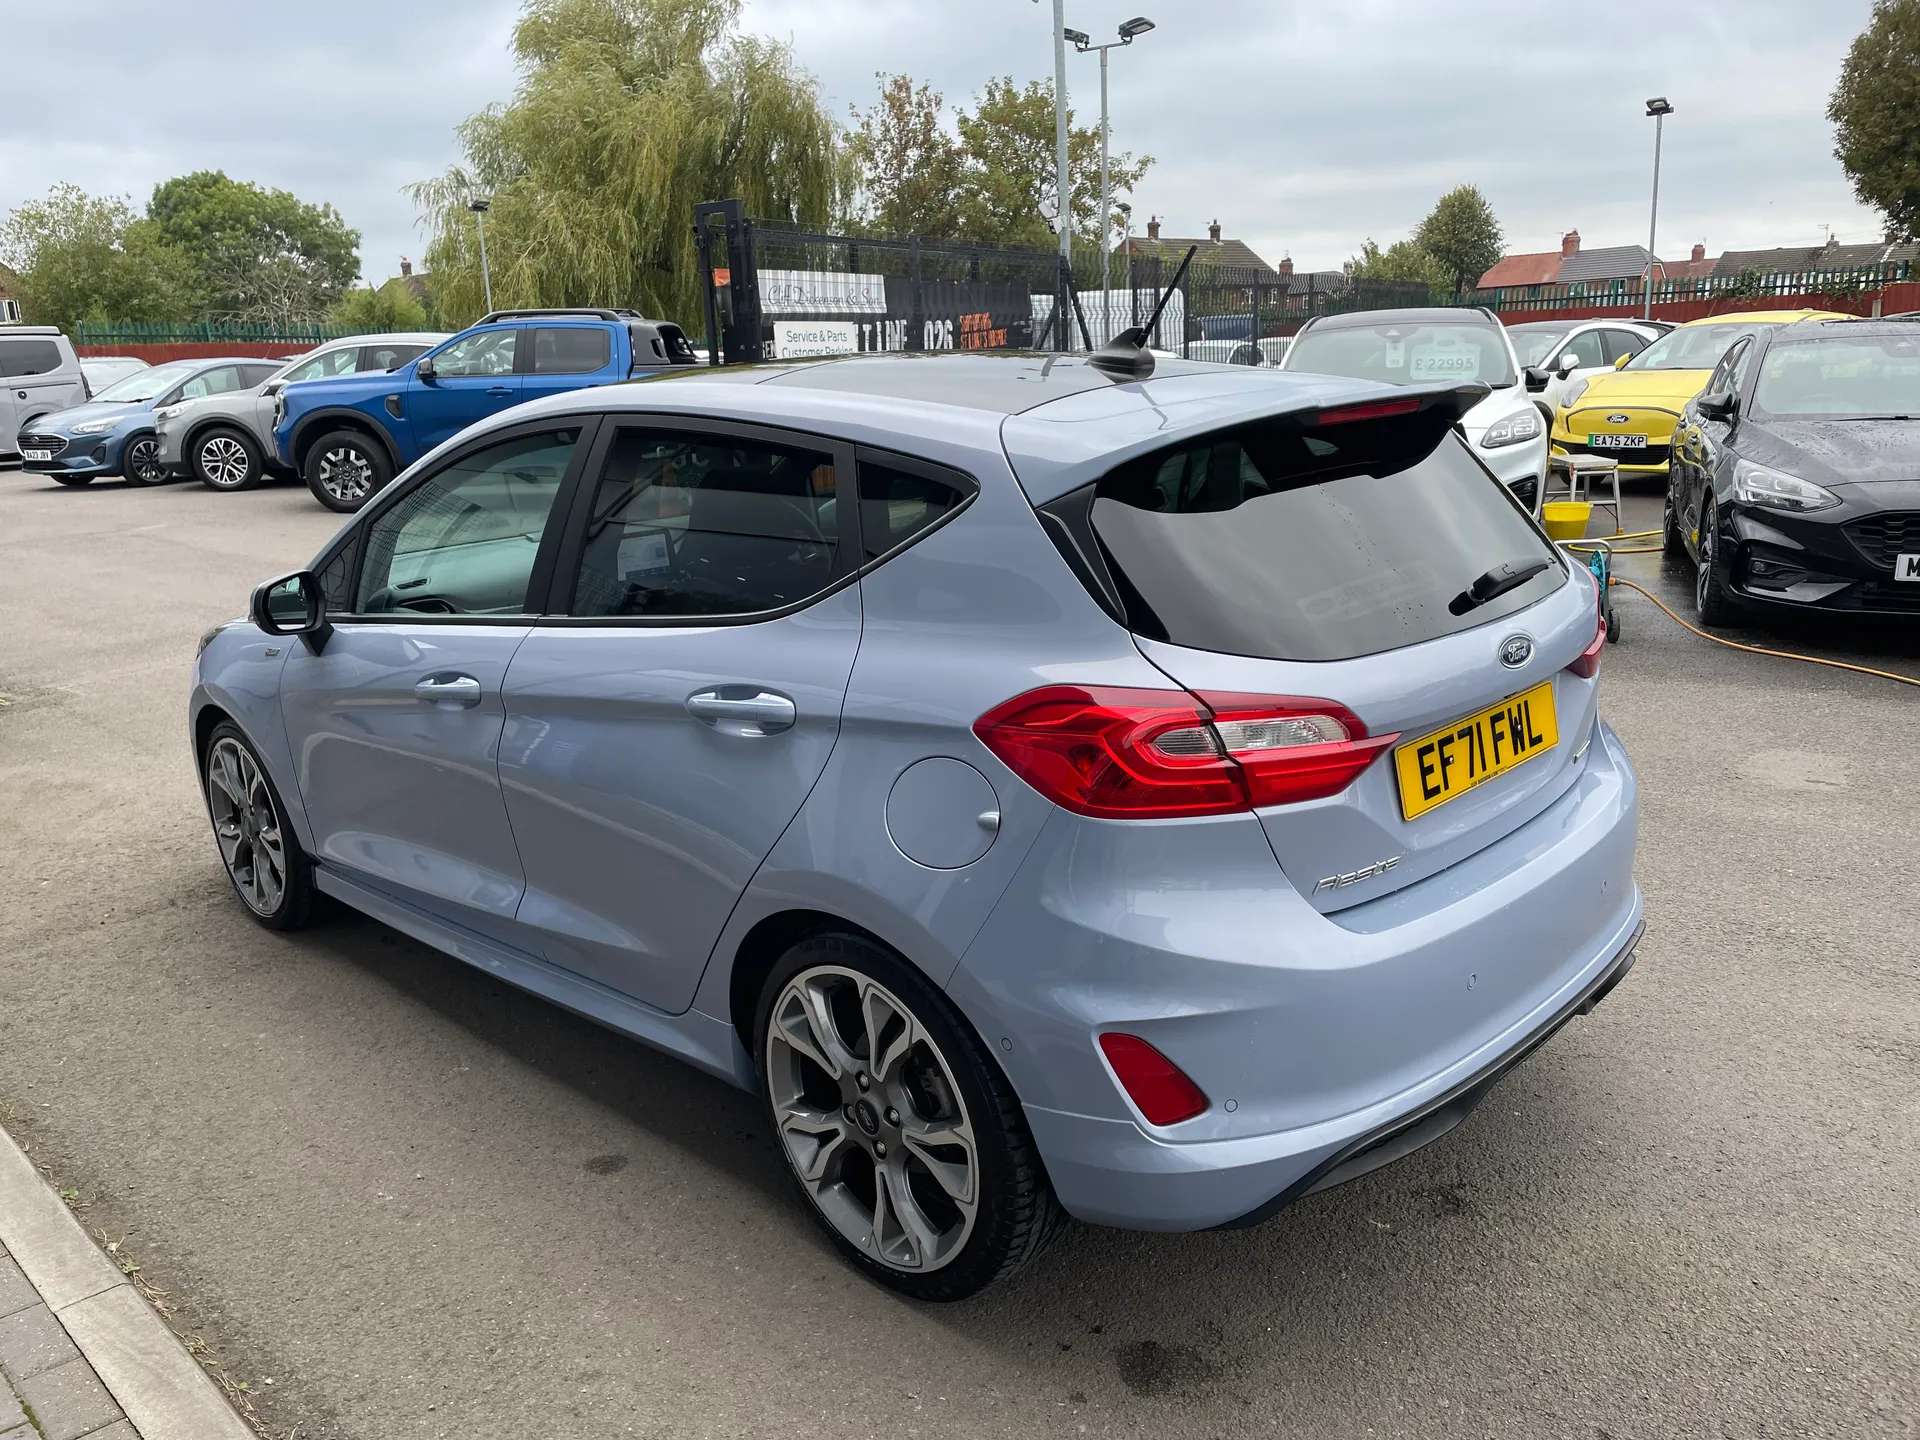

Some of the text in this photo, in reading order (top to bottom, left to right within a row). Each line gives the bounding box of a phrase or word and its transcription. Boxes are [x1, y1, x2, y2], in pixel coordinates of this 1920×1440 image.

[847, 288, 859, 305] &
[860, 288, 882, 305] Son
[786, 330, 847, 343] Service & Parts
[1428, 358, 1474, 370] 22995
[1594, 435, 1644, 446] EA75 ZKP
[1416, 699, 1543, 801] EF71 FWL
